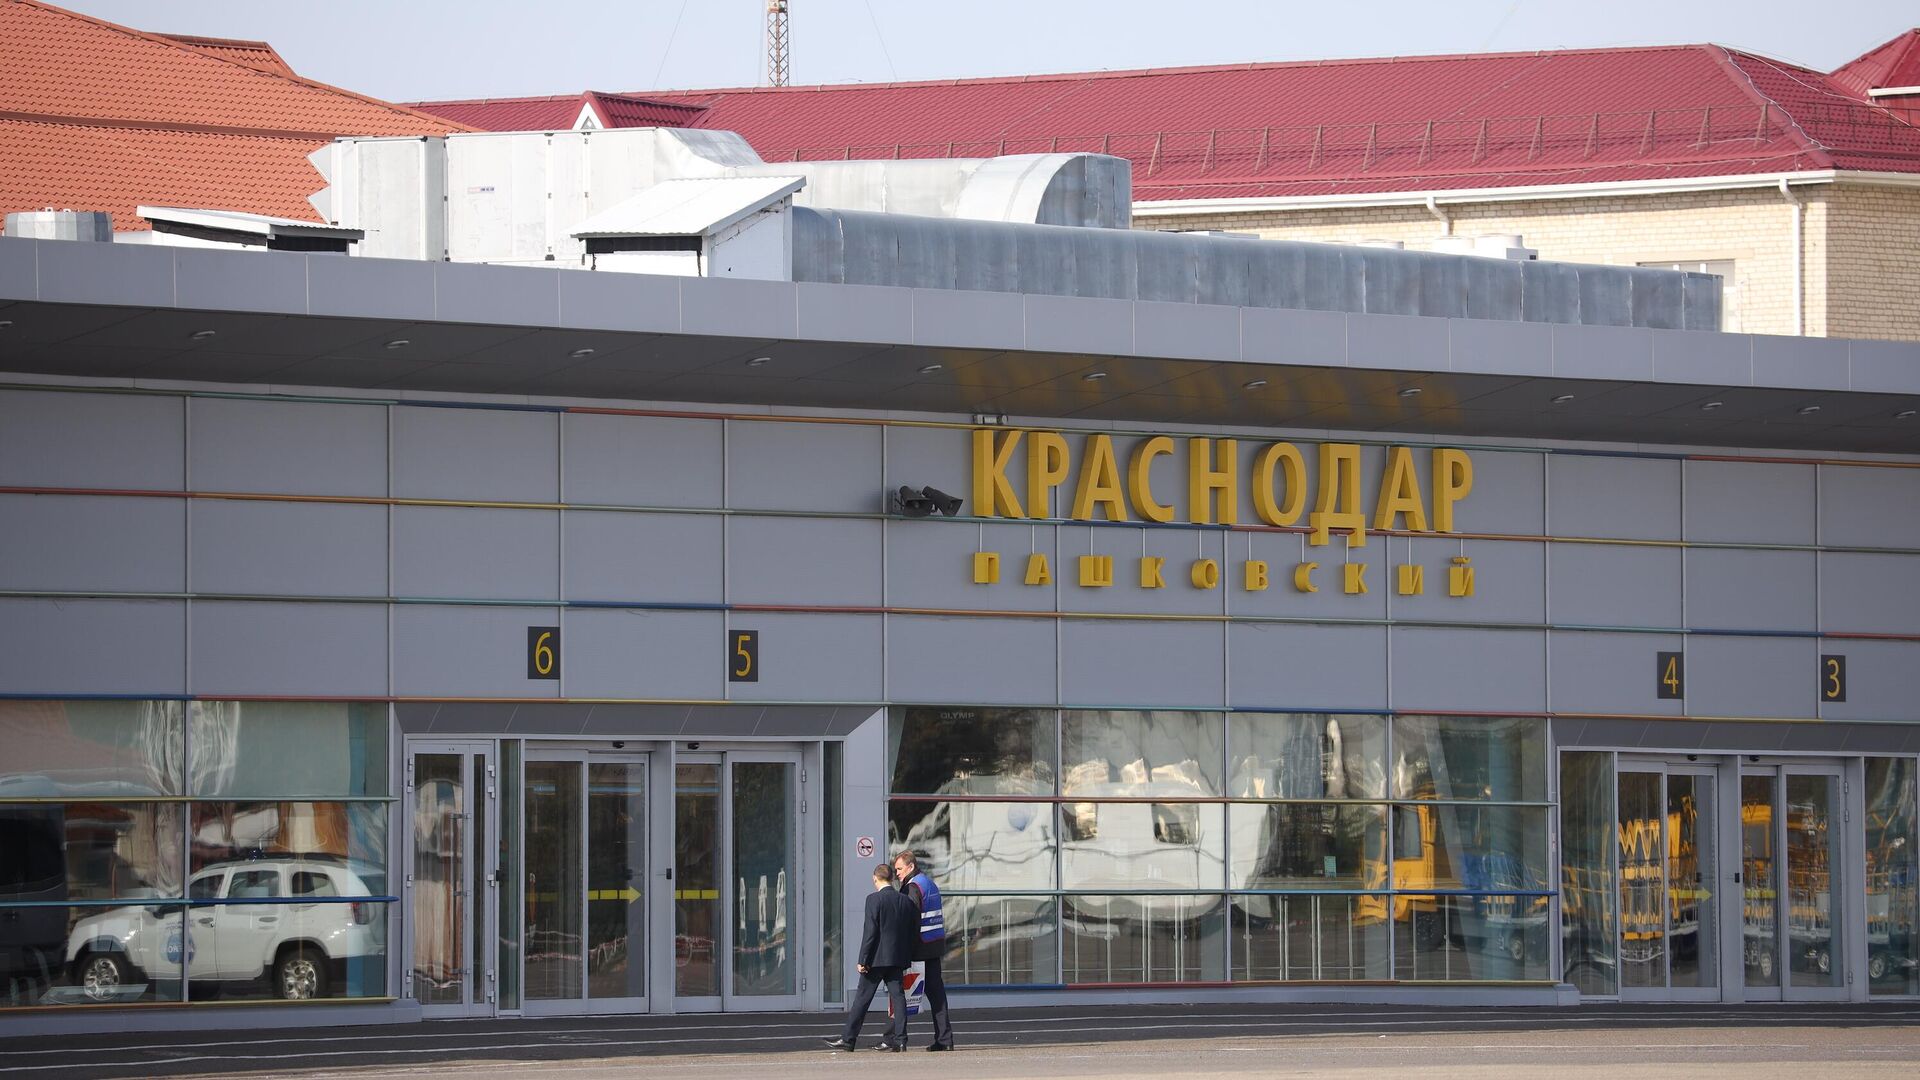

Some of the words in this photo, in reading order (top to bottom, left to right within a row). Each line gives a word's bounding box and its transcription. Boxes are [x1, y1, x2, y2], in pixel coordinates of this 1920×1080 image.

[973, 429, 1473, 546] КРАСНОДАР
[974, 552, 1475, 597] ПАШКОВСКИЙ
[535, 632, 553, 675] 6
[735, 635, 751, 677] 5
[1663, 657, 1679, 694] 4
[1827, 659, 1841, 697] 3
